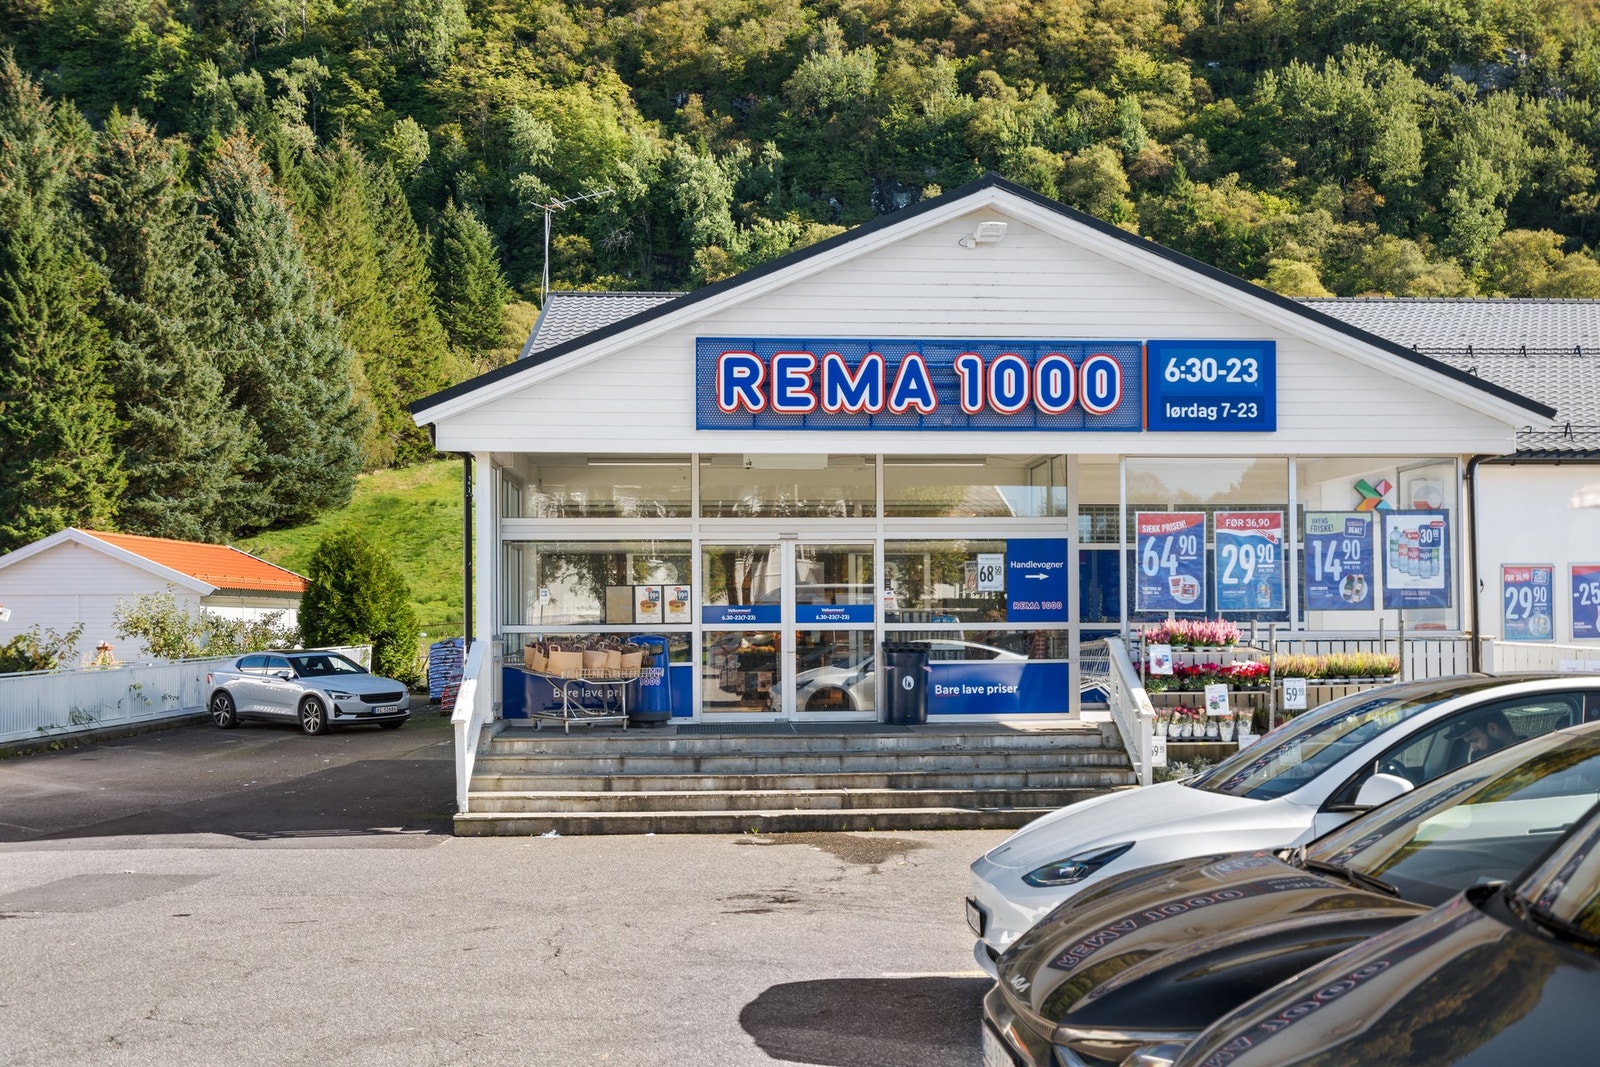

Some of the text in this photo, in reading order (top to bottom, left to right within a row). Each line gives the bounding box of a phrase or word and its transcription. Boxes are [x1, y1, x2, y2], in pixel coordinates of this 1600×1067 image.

[1164, 358, 1259, 384] 6:30-23
[716, 350, 1123, 415] REMA 1000
[1166, 401, 1258, 422] lørdag 7-23
[1142, 520, 1187, 533] SJEKK PRISEN!
[1225, 518, 1244, 527] FØR
[1310, 524, 1334, 533] FRISKE!
[1420, 529, 1432, 543] 30
[1142, 535, 1197, 577] 64 90
[1313, 539, 1360, 581] 14 90
[1010, 560, 1064, 570] Handlevogner
[1221, 544, 1275, 584] 29 90
[980, 565, 994, 582] 68
[995, 565, 1002, 574] 50
[1013, 601, 1062, 610] REMA 1000
[1505, 586, 1547, 619] 29 90
[640, 677, 661, 686] 1000
[582, 688, 603, 697] lave
[935, 683, 1018, 696] Bare lave priser
[1286, 688, 1298, 701] 59
